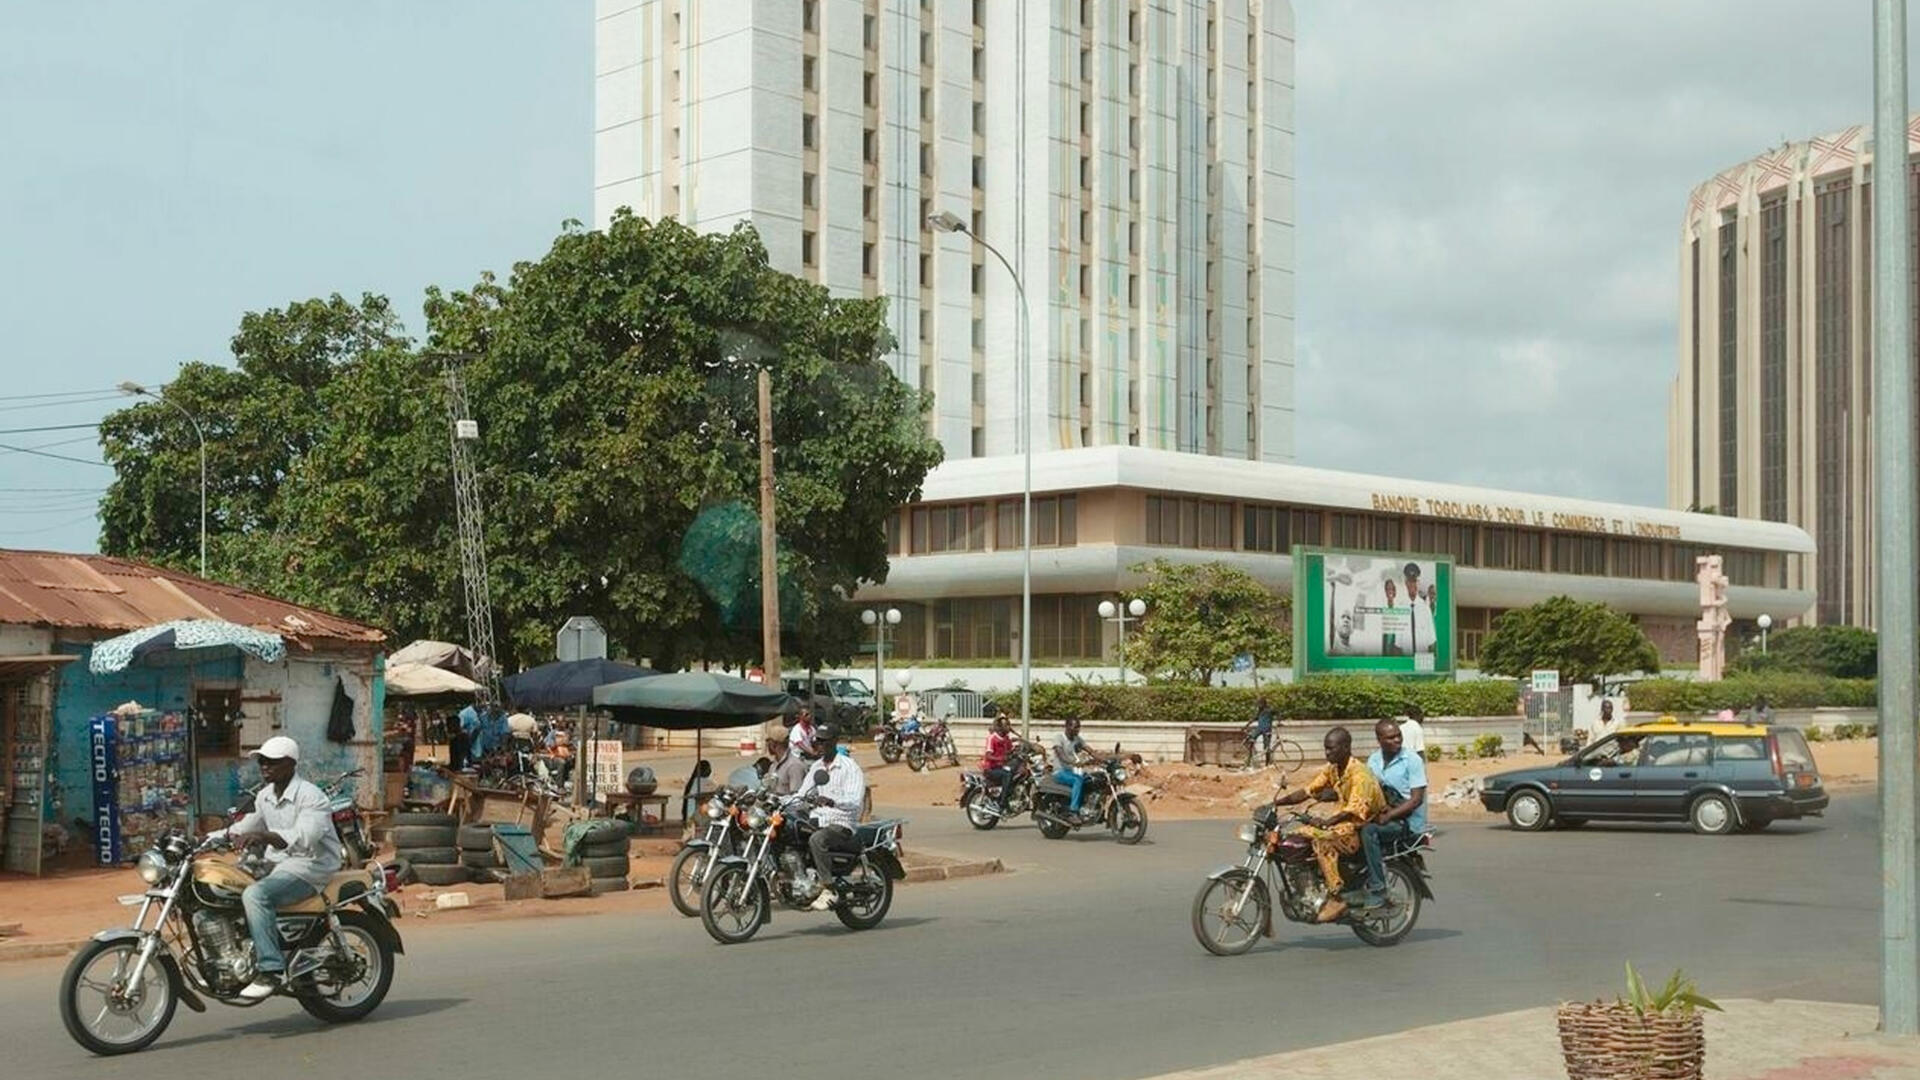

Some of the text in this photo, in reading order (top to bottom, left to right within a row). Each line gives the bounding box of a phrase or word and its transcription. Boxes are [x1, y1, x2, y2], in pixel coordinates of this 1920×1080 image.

[1371, 494, 1420, 513] BANQUE
[1497, 506, 1526, 524] POUR
[1532, 510, 1545, 526] LE
[1552, 512, 1606, 532] COMMERCE
[1612, 519, 1623, 534] ET
[93, 721, 107, 782] TECNO
[98, 803, 111, 863] TECNO
